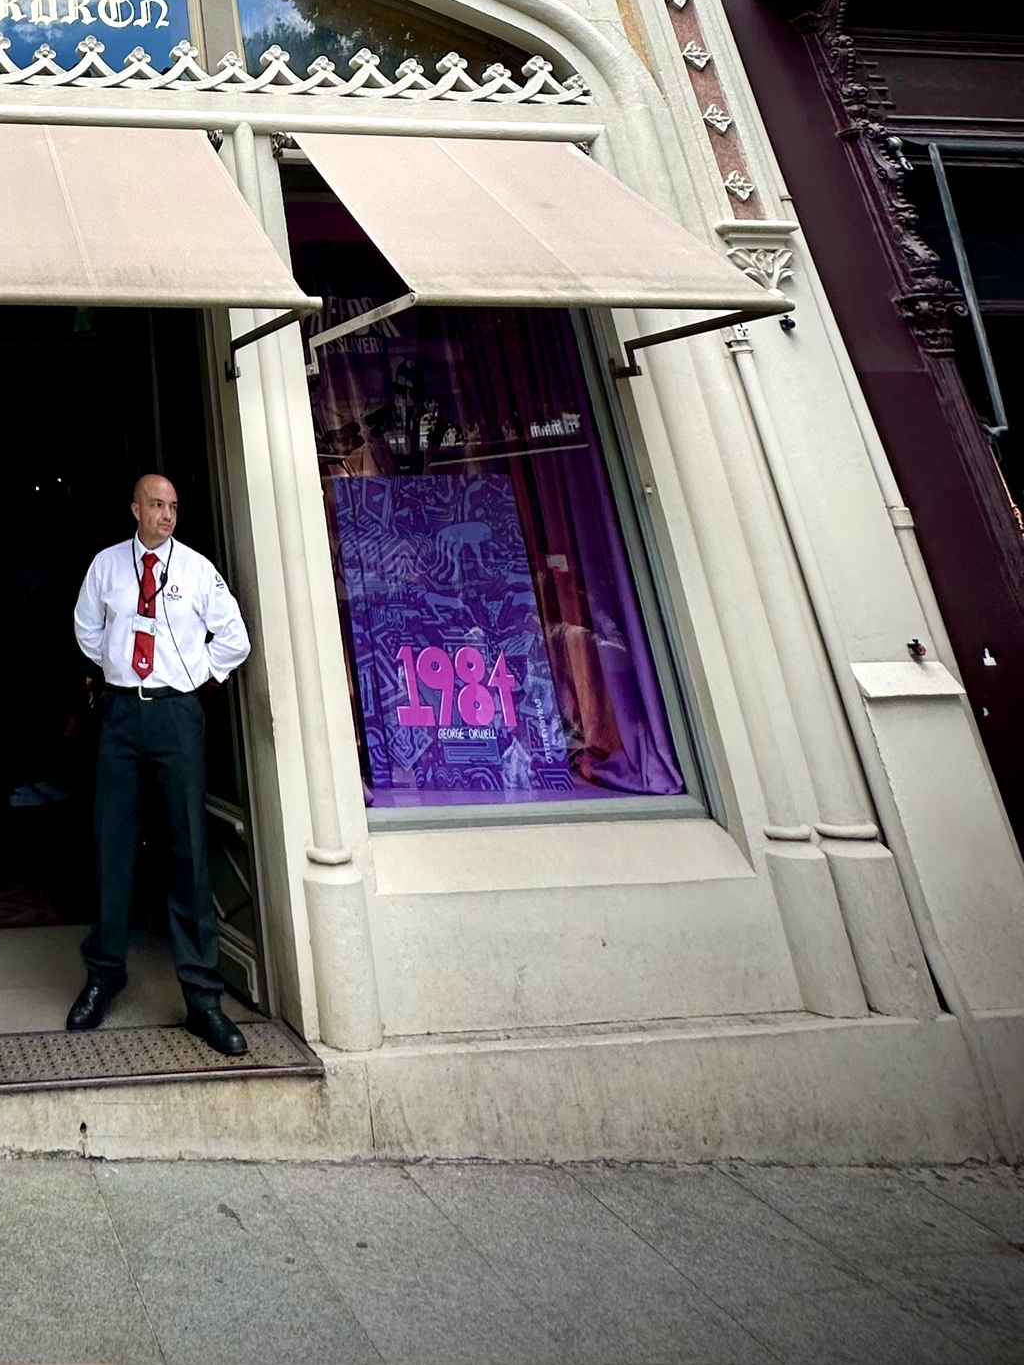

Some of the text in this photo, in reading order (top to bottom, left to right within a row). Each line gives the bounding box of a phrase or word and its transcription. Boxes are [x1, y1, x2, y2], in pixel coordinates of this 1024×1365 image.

[337, 336, 384, 354] SLAVERY
[396, 645, 518, 727] 1984
[437, 727, 498, 740] GEORGE ORWELL
